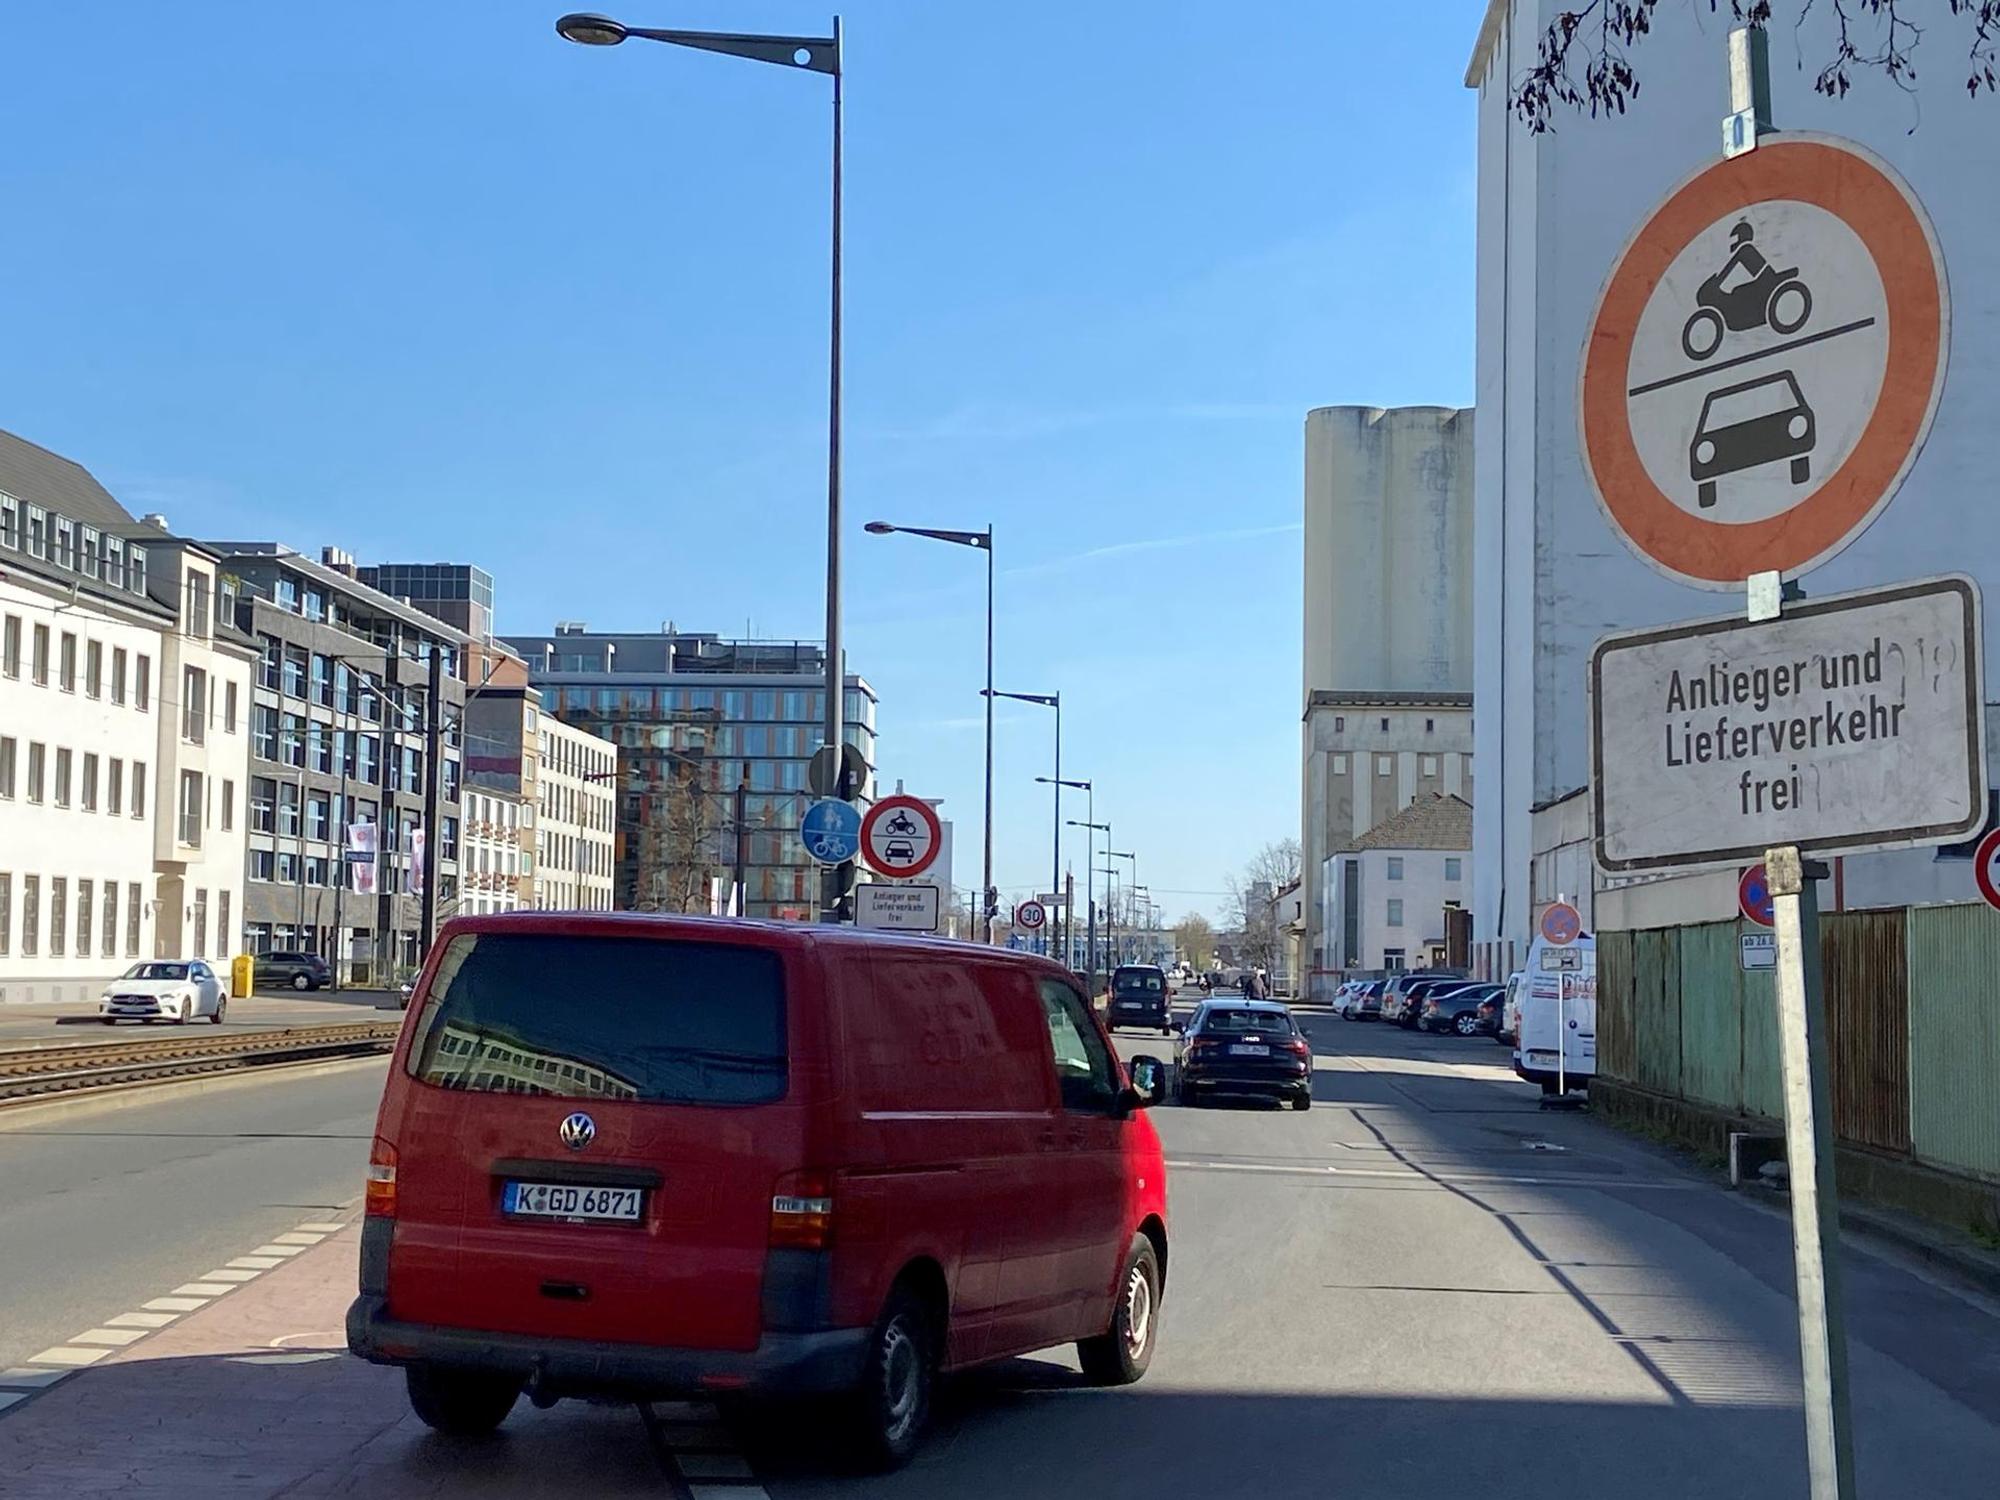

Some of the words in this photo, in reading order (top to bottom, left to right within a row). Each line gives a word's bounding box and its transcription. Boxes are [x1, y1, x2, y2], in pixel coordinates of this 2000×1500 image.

[1666, 661, 1807, 713] Anlieger
[1819, 636, 1882, 689] und
[1666, 694, 1905, 767] Lieferverkehr
[1739, 764, 1799, 816] frei
[872, 902, 925, 912] Lieferverkehr
[873, 891, 905, 903] Anlieger
[907, 892, 921, 902] und
[888, 912, 903, 922] frei
[1023, 908, 1041, 922] 30
[519, 1187, 534, 1209] K
[549, 1188, 578, 1213] GD
[583, 1190, 636, 1215] 6871
